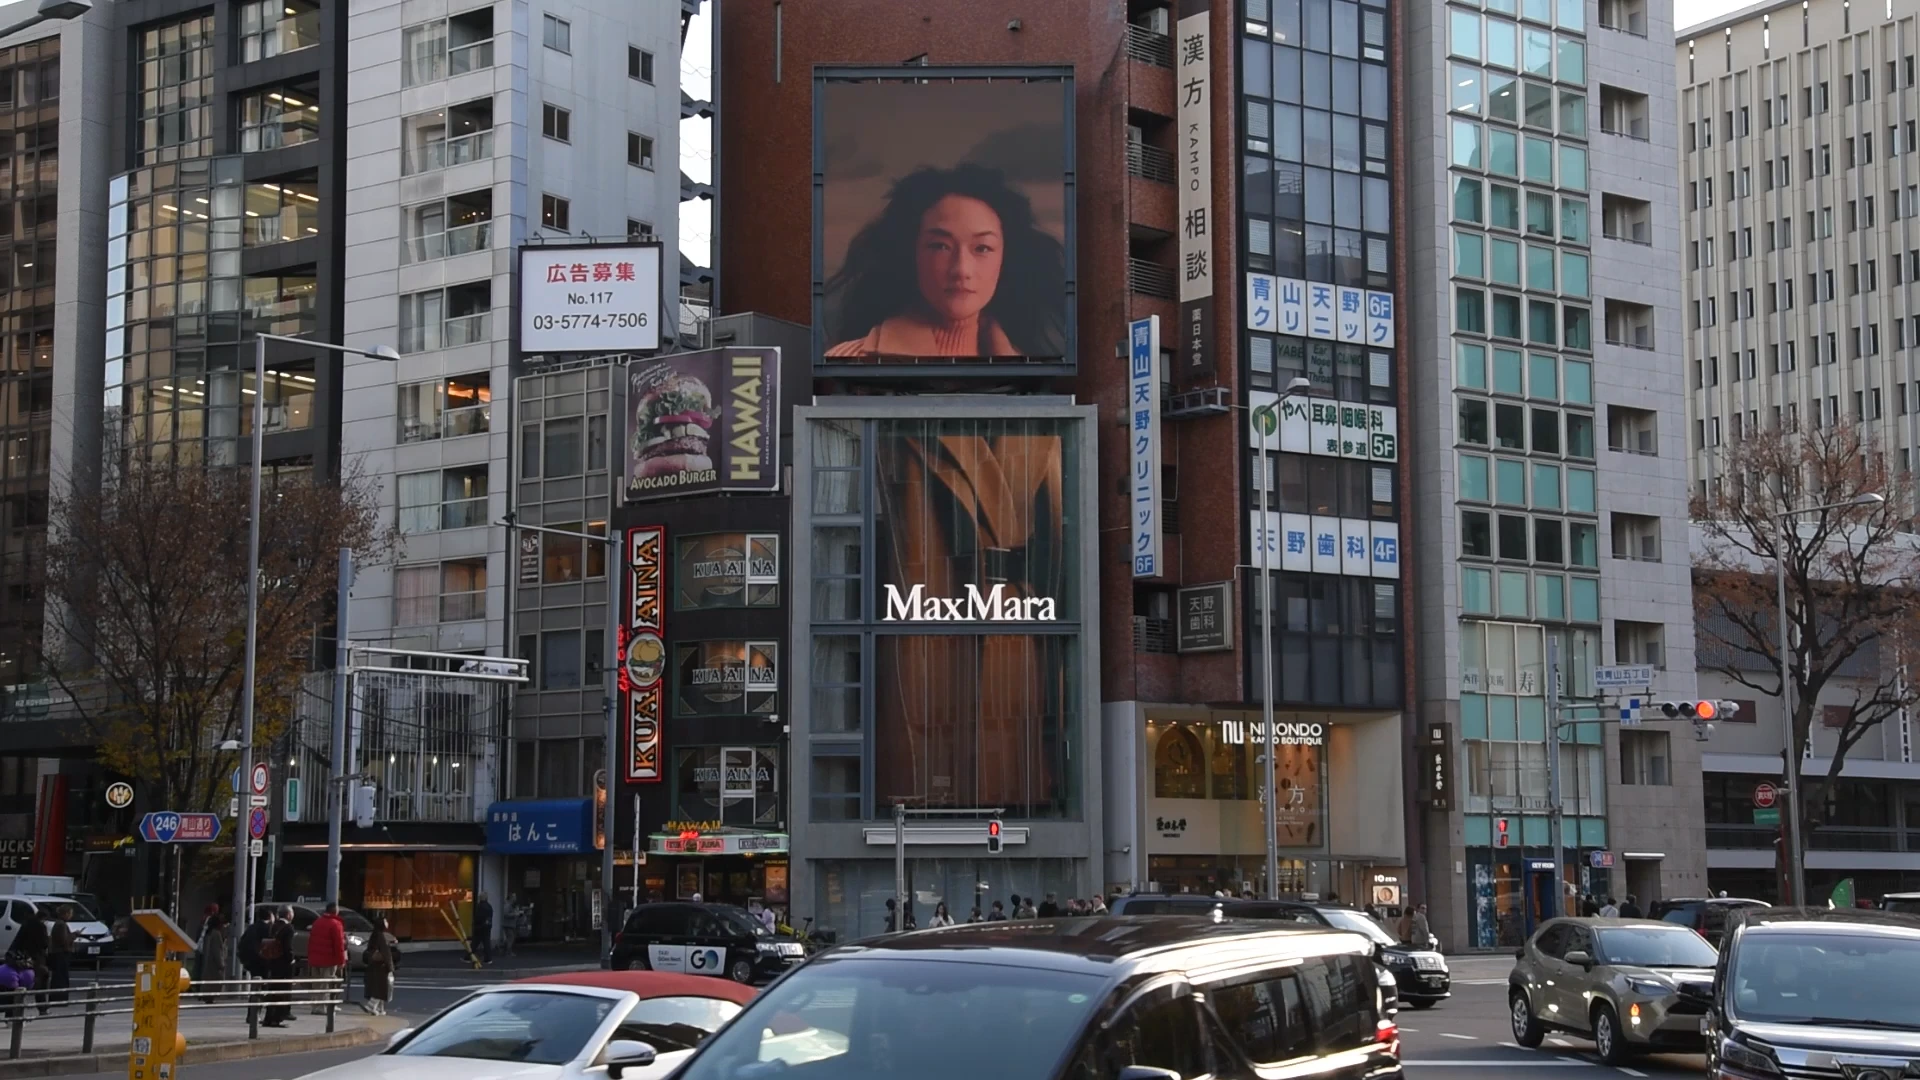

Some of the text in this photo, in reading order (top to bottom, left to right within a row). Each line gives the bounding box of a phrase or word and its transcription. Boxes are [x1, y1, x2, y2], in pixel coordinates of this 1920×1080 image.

[1183, 34, 1204, 108] 漢方
[1189, 123, 1199, 192] KAMPO
[1185, 208, 1207, 282] 相談
[547, 262, 636, 283] 広告募集
[568, 292, 613, 305] No.117
[1252, 277, 1390, 315] 青山天野 6F
[533, 313, 648, 330] 03-5774-7506
[1254, 306, 1388, 342] クリニック
[1314, 344, 1328, 354] Ear
[1311, 356, 1330, 366] Nose
[730, 356, 762, 480] HAWAII
[1134, 325, 1154, 574] 青山天野クリニック 6F
[1326, 437, 1394, 457] 表参道 5F
[630, 470, 716, 490] AVOCADO BURGER
[1375, 540, 1395, 560] 4F
[693, 562, 722, 578] KUA
[883, 584, 1056, 621] MaxMara
[634, 534, 660, 771] KUA AINA
[692, 668, 722, 684] KUA
[1281, 737, 1322, 746] BOUTIQUE
[256, 771, 264, 785] 40
[156, 816, 177, 831] 246
[508, 822, 558, 842] はんこ
[667, 820, 721, 832] HAWAII
[691, 950, 719, 970] GO
